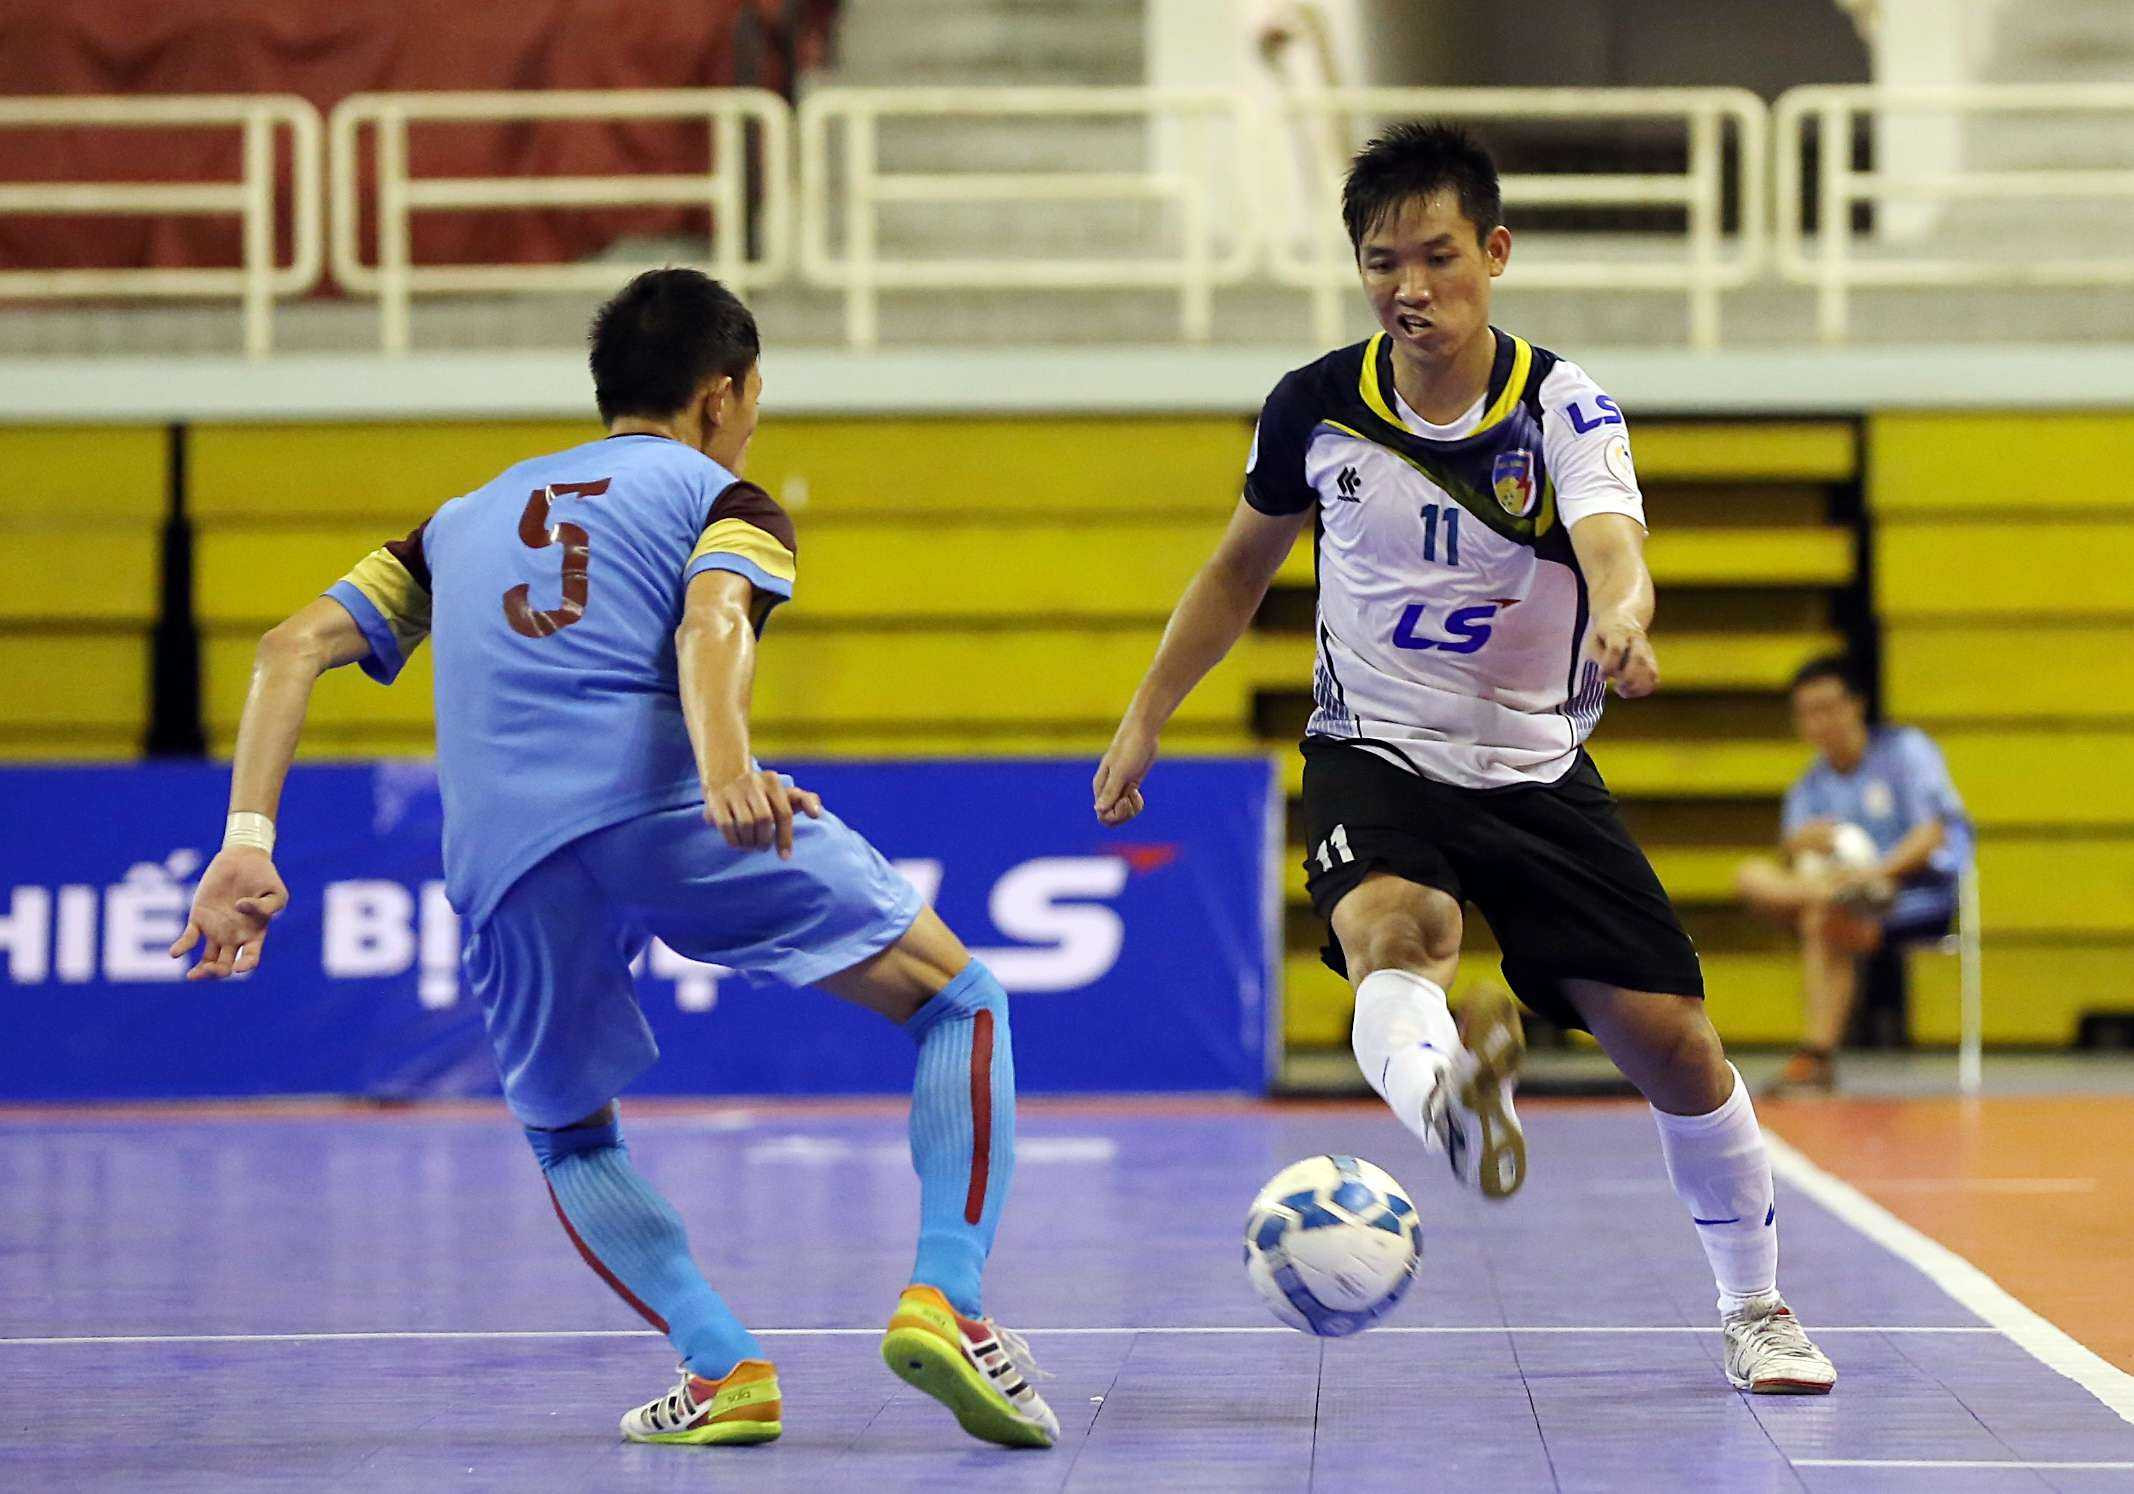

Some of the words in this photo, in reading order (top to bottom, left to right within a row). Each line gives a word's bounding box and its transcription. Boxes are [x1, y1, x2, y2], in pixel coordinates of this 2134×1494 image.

[1566, 394, 1622, 434] LS
[502, 477, 612, 638] 5
[1420, 503, 1459, 566] 11
[1393, 604, 1498, 654] LS
[1315, 823, 1355, 872] 11
[321, 880, 460, 1010] BỊ
